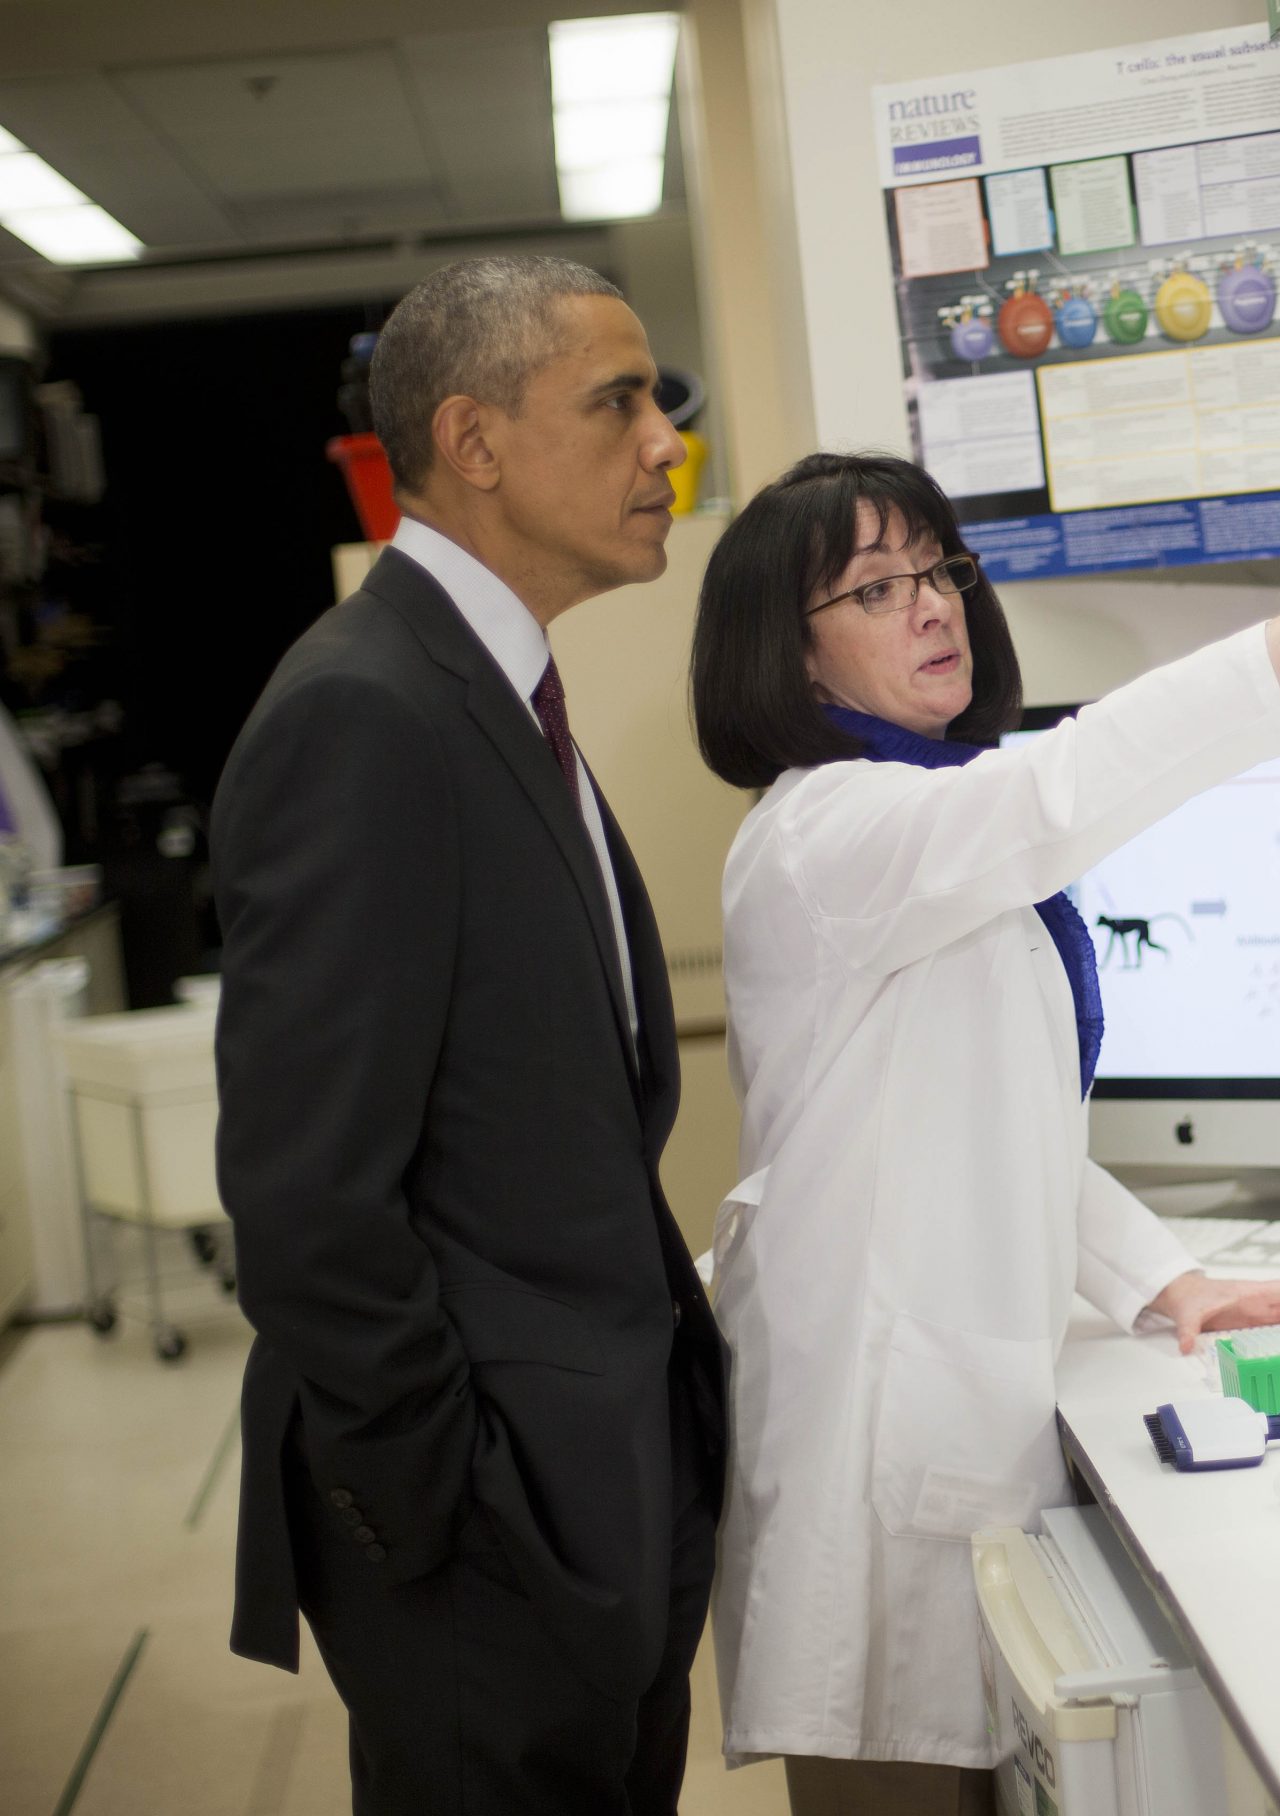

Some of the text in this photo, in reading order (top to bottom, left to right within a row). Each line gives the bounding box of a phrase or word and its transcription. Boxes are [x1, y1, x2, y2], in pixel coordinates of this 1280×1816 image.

[1166, 54, 1185, 66] the
[889, 90, 976, 121] nature
[890, 114, 980, 143] REVIEWS
[1011, 1696, 1056, 1790] REVCO
